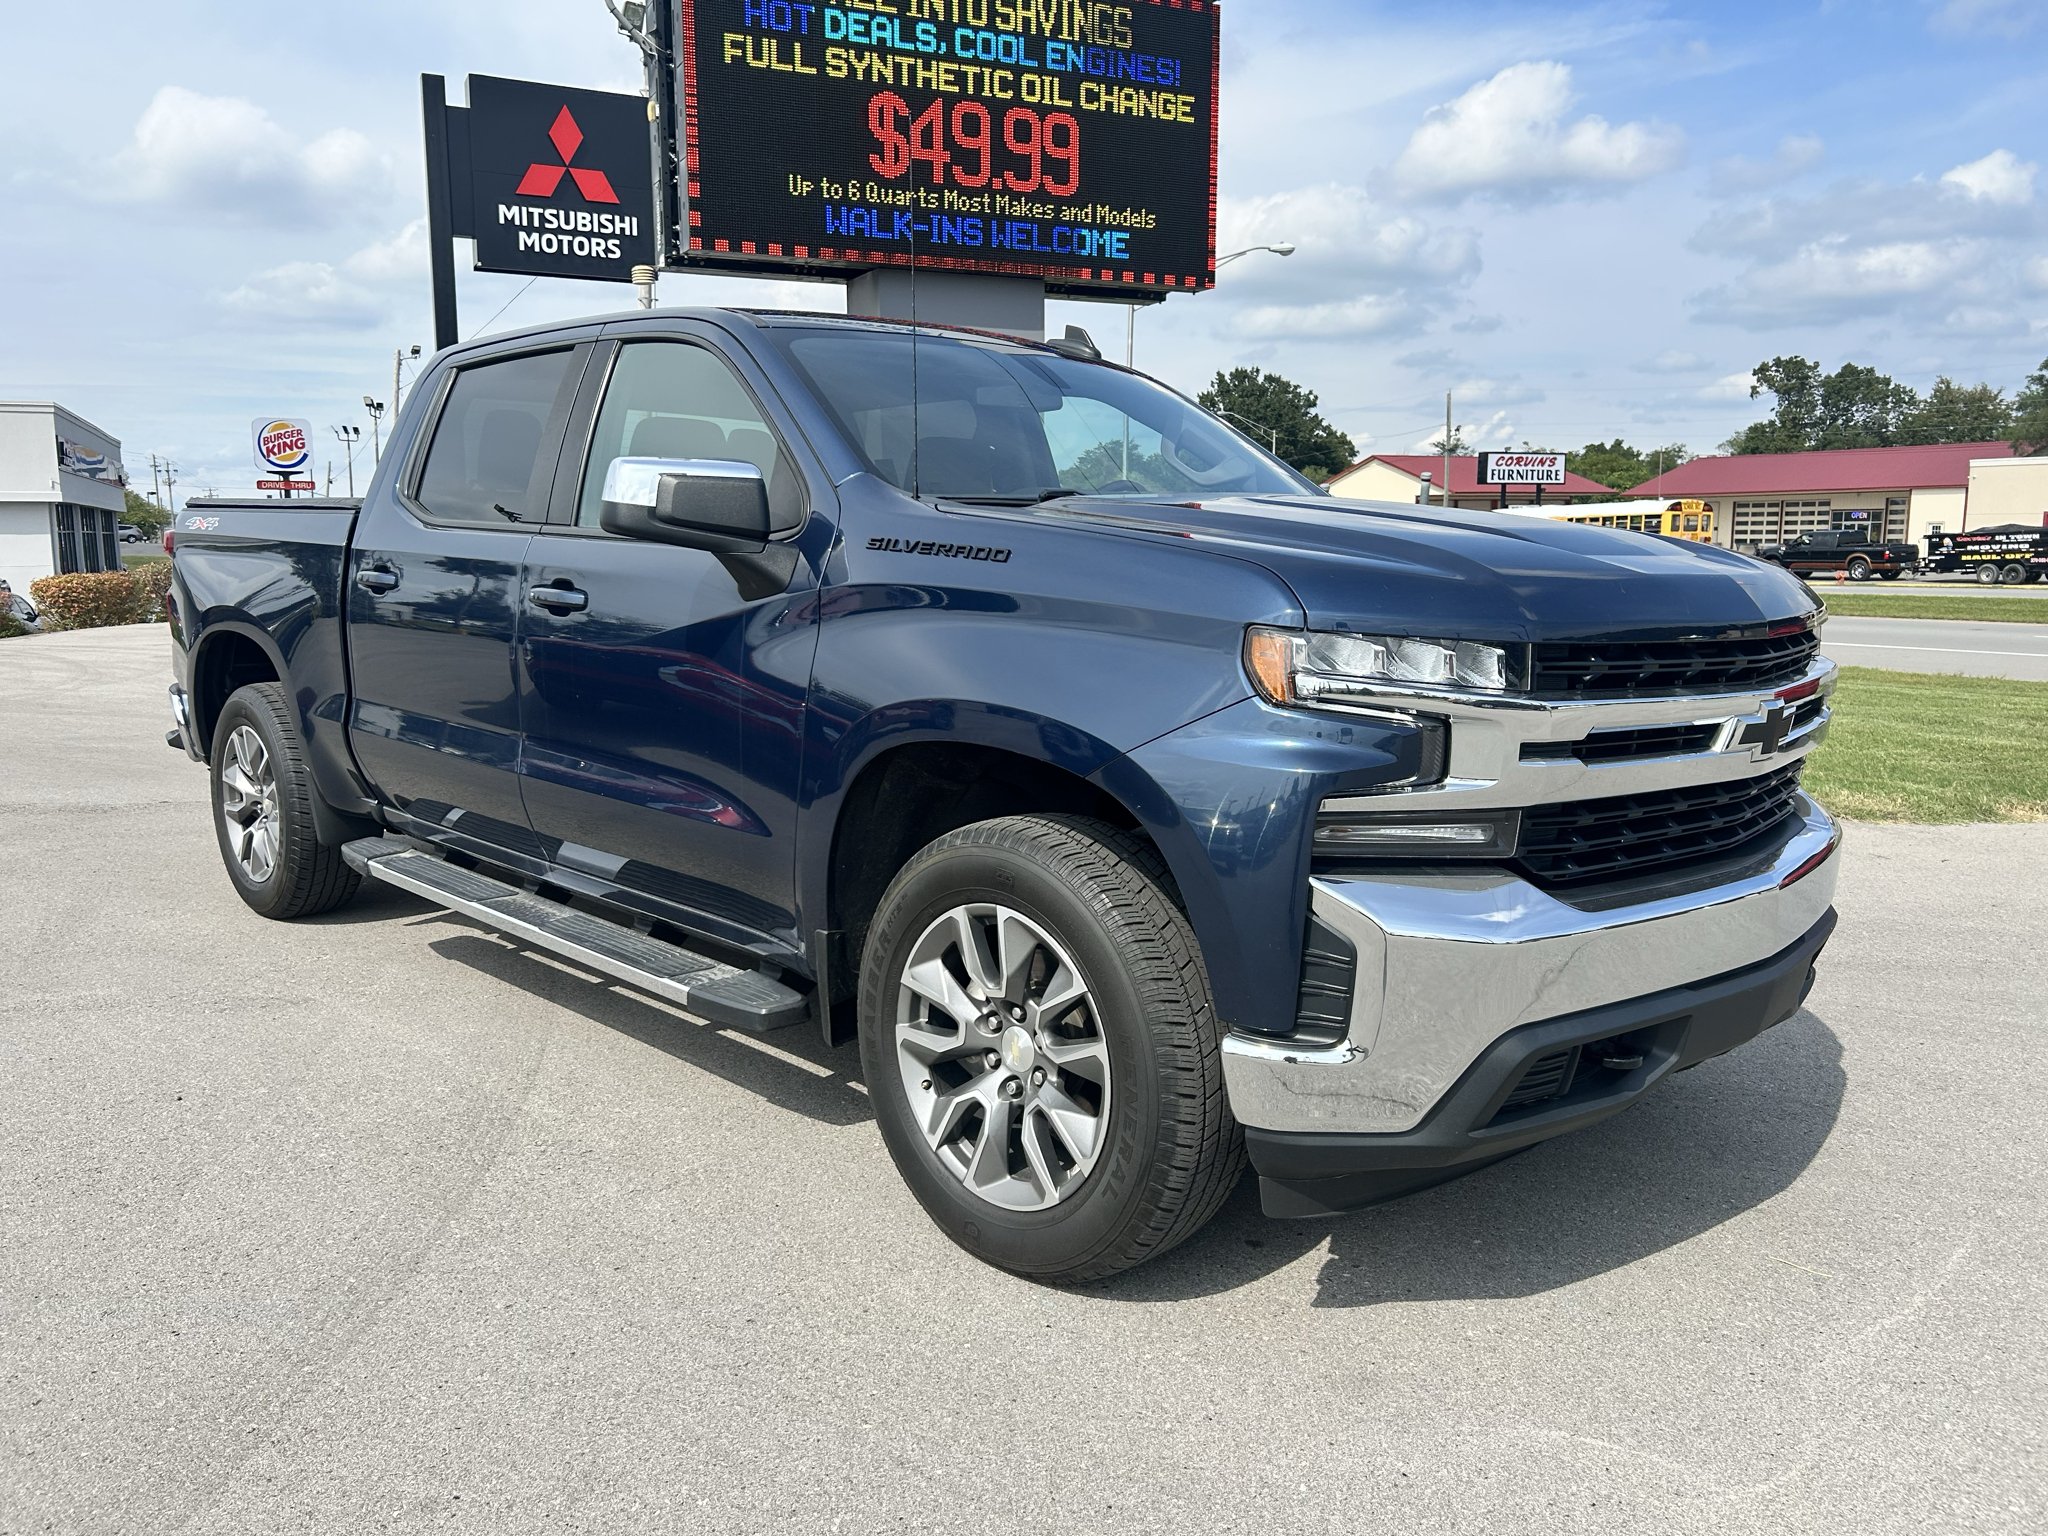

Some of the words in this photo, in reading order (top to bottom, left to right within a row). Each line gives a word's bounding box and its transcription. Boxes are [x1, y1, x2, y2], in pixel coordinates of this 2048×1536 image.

[995, 0, 1133, 49] SAVINGS
[743, 0, 815, 35] HOT
[824, 8, 947, 55] DEALS,
[954, 27, 1039, 68] COOL
[1046, 40, 1181, 87] ENGINES!
[723, 33, 818, 75] FULL
[825, 46, 1014, 100] SYNTHETIC
[1020, 73, 1073, 108] OIL
[1079, 81, 1196, 123] CHANGE
[868, 90, 1080, 197] $49.99
[788, 173, 815, 197] Up
[820, 177, 843, 199] to
[848, 180, 861, 201] 6
[865, 181, 939, 208] Quarts
[944, 188, 991, 214] Most
[995, 194, 1055, 219] Makes
[1059, 203, 1092, 223] and
[1096, 204, 1157, 229] Models
[497, 203, 639, 237] MITSUBISHI
[825, 204, 983, 246] WALK-INS
[991, 219, 1130, 260] WELCOME
[518, 231, 622, 259] MOTORS
[263, 428, 303, 447] BURGER
[265, 437, 306, 459] KING
[1490, 468, 1561, 481] FURNITURE
[1495, 455, 1558, 468] CORVIN'S
[261, 481, 286, 489] DRIVE
[1851, 511, 1868, 519] OPEN
[865, 537, 1013, 563] SILVERADO
